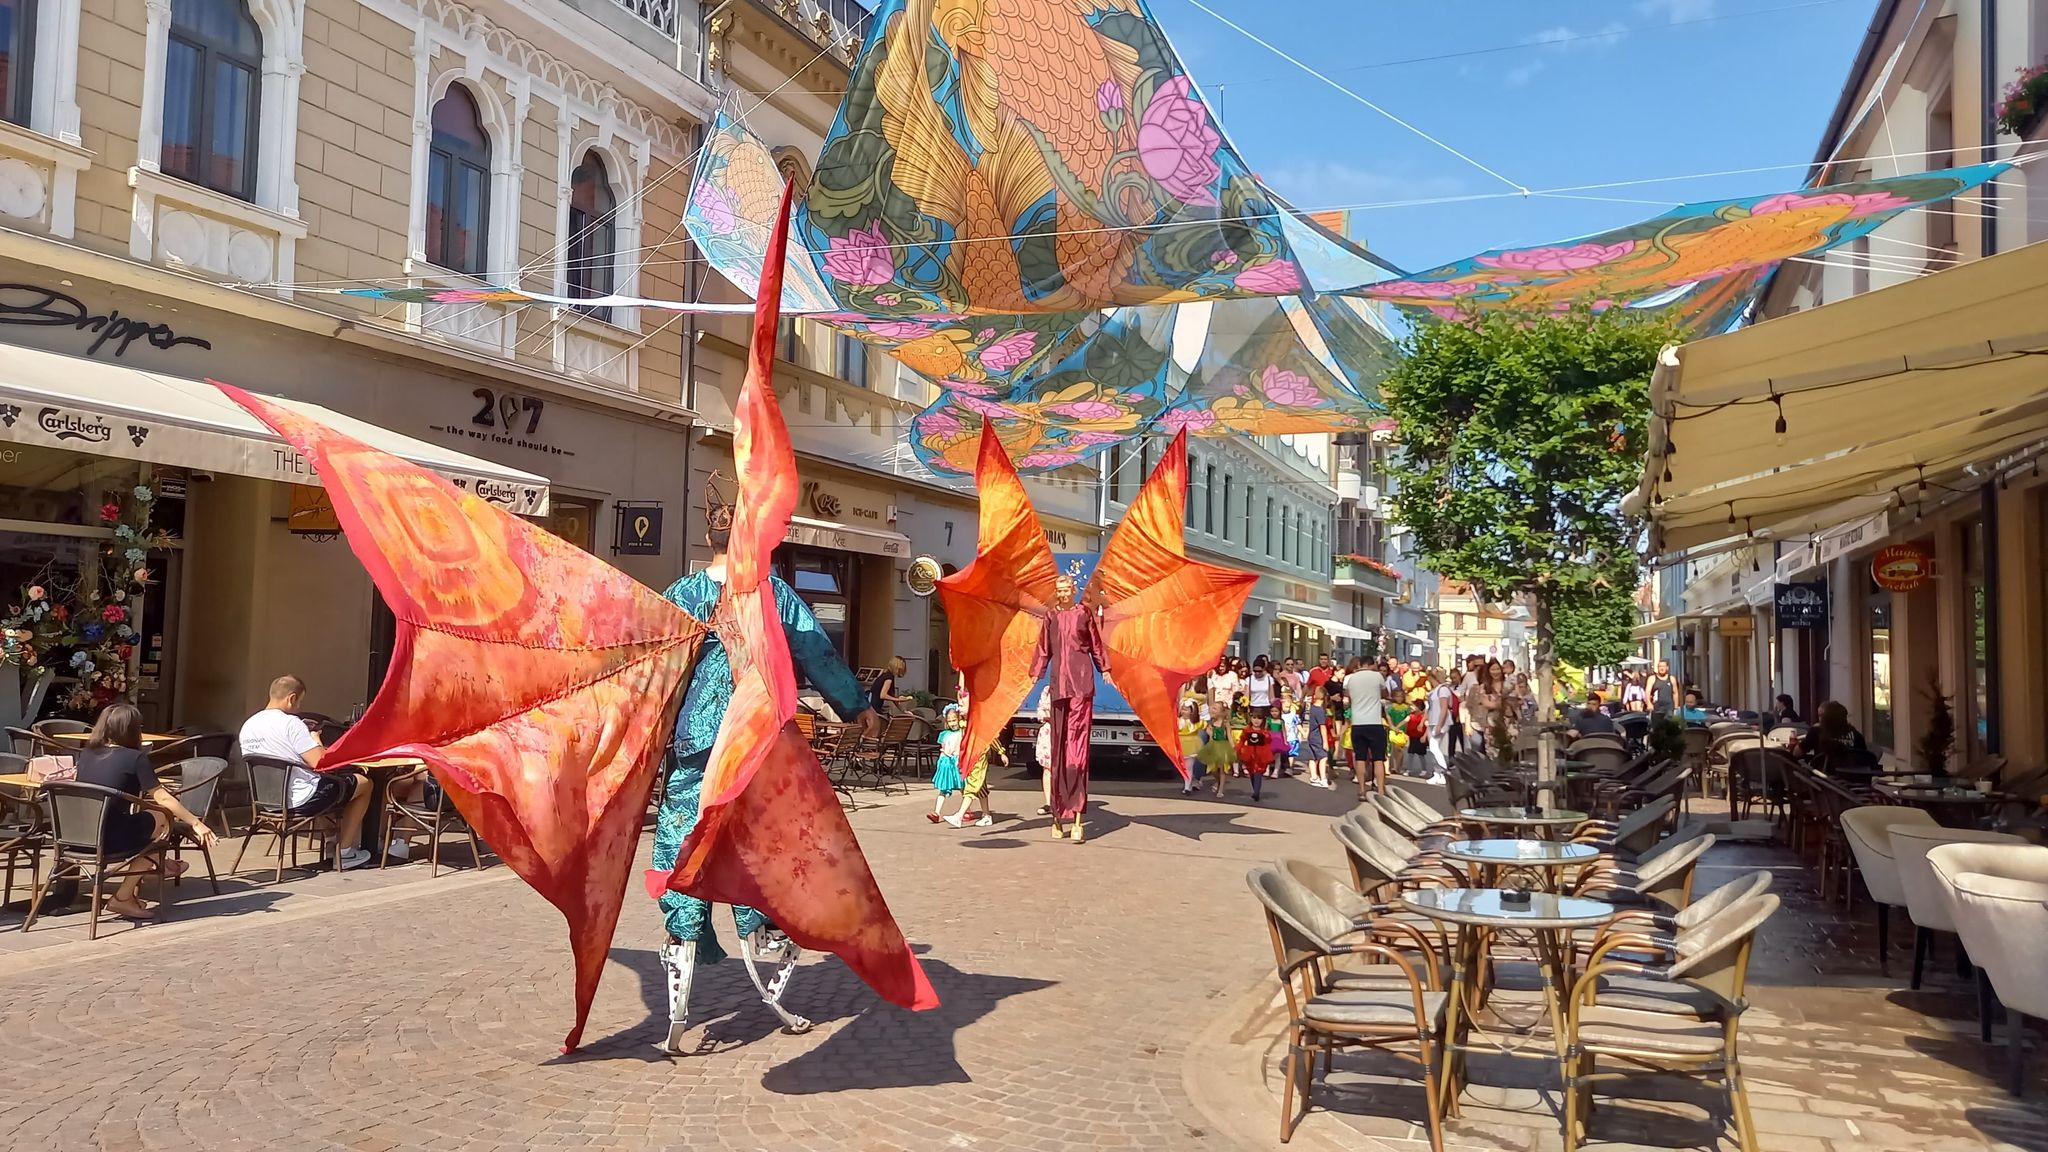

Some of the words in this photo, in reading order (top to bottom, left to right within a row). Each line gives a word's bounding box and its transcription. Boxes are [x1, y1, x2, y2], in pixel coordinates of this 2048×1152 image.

[38, 407, 112, 442] Carlsberg
[446, 425, 464, 436] the
[468, 429, 487, 441] way
[491, 433, 513, 445] food
[517, 439, 548, 453] should
[551, 445, 562, 455] be
[273, 449, 304, 474] THE
[475, 479, 516, 503] Carlsberg
[944, 521, 954, 547] 7
[1043, 528, 1067, 550] ORIA'S
